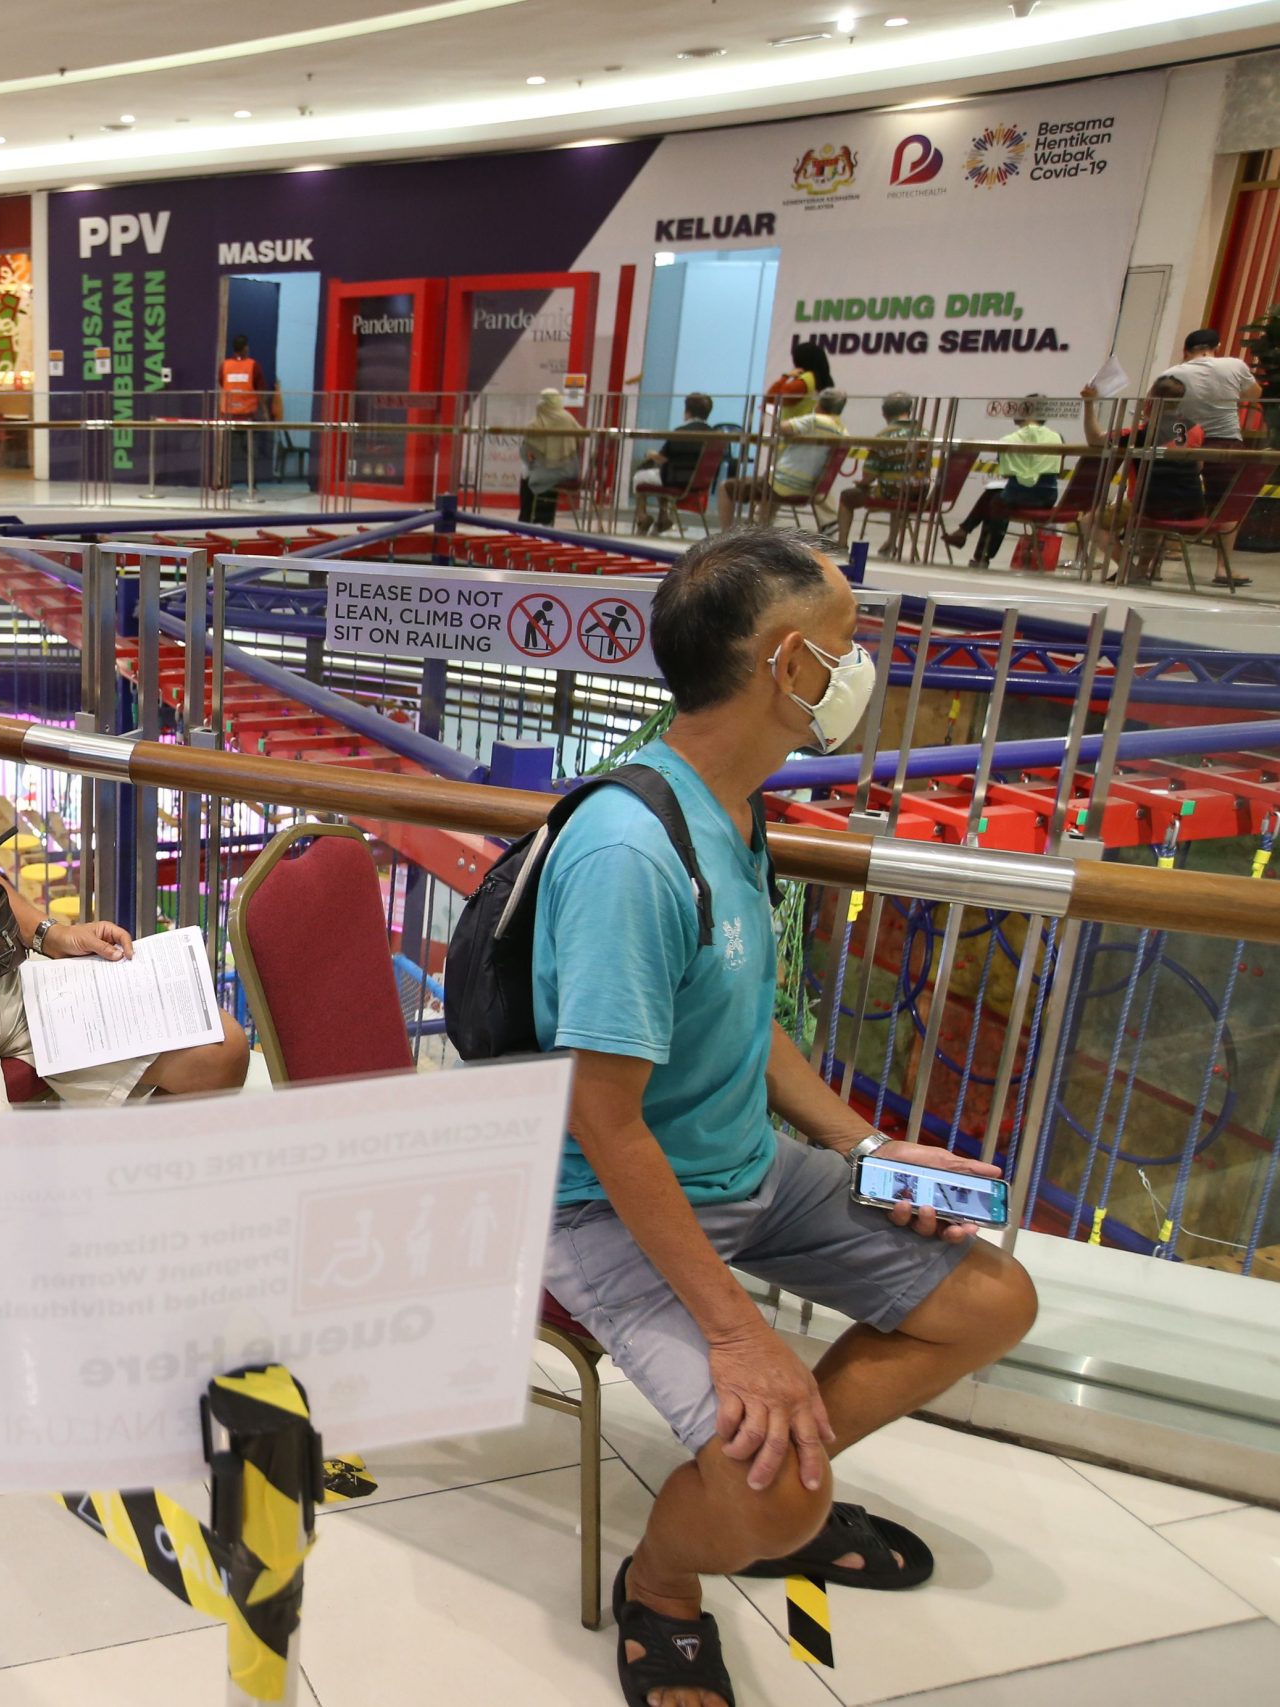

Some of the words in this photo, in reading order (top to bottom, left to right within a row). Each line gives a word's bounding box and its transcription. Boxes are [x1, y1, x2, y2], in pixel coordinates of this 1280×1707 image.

[1037, 117, 1115, 137] Bersama
[1034, 132, 1112, 151] Hentikan
[1034, 146, 1096, 166] Wabak
[1030, 160, 1107, 181] Covid-19
[79, 211, 171, 258] PPV
[654, 212, 777, 243] KELUAR
[219, 238, 315, 266] MASUK
[473, 307, 572, 331] Pandemic
[794, 294, 936, 323] LINDUNG
[944, 291, 1024, 321] DIRI,
[82, 274, 104, 380] PUSAT
[144, 270, 166, 393] VAKSIN
[352, 313, 414, 335] Pandemi
[531, 329, 571, 343] TIMES
[938, 327, 1070, 354] SEMUA.
[113, 272, 134, 470] PEMBERIAN
[1173, 422, 1188, 447] 3
[335, 581, 412, 601] PLEASE
[418, 587, 450, 604] DO
[457, 589, 503, 608] NOT
[335, 603, 393, 625] LEAN,
[399, 608, 463, 628] CLIMB
[469, 613, 502, 631] OR
[333, 624, 364, 641] SIT
[369, 627, 400, 645] ON
[405, 630, 491, 653] RAILING
